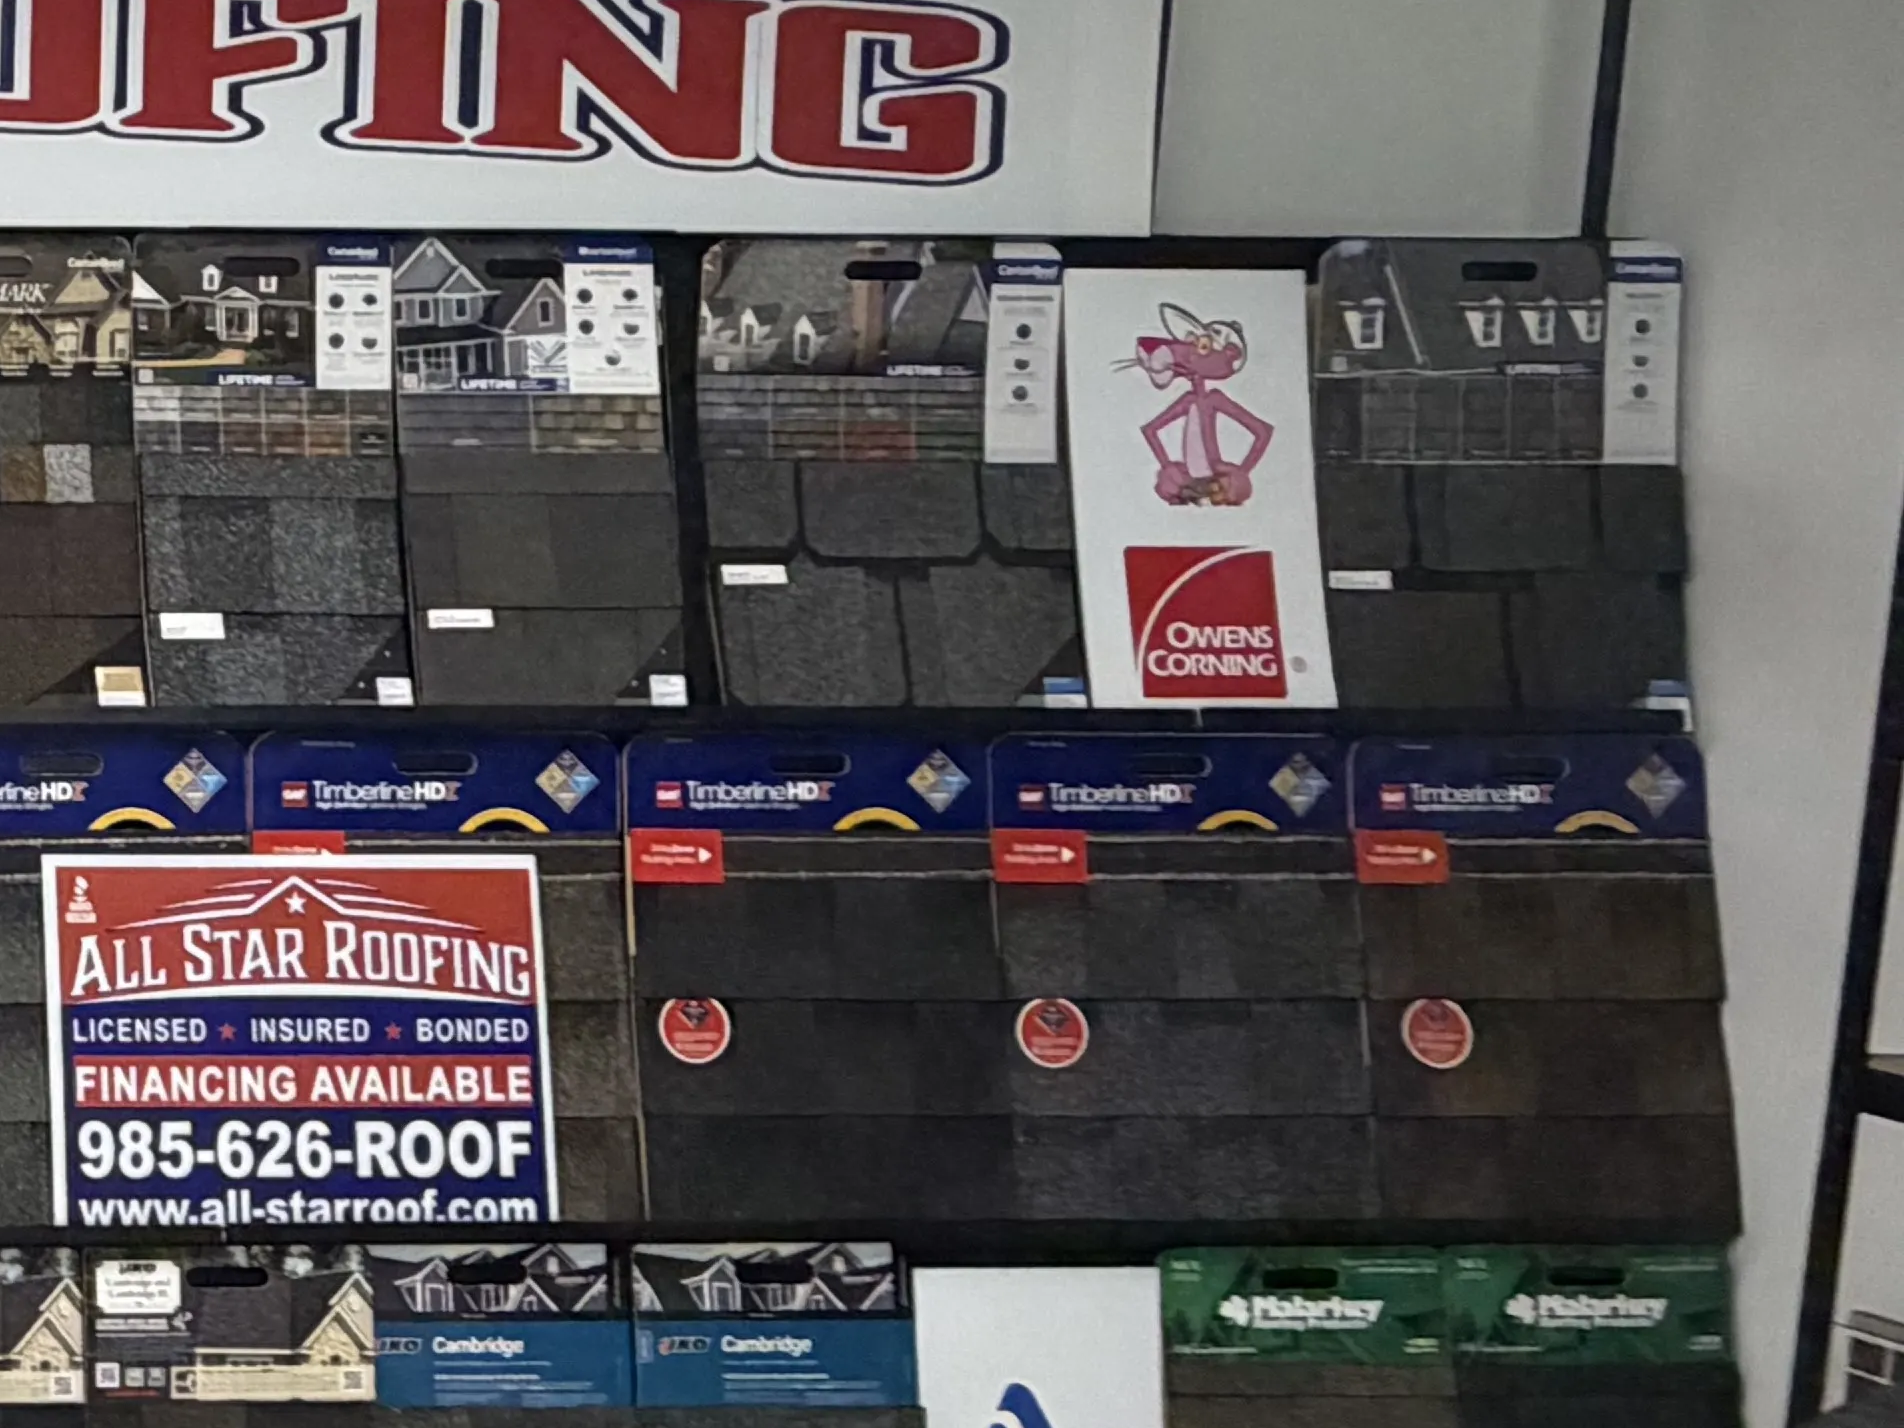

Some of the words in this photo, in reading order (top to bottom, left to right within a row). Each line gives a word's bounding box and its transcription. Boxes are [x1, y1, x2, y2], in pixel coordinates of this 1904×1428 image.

[1166, 621, 1274, 649] OWENS
[1147, 650, 1278, 678] CORNING
[70, 934, 167, 997] ALL
[182, 922, 308, 983] STAR
[322, 919, 532, 998] ROOFING
[73, 1016, 207, 1043] LICENSED
[250, 1018, 370, 1043] INSURED
[416, 1018, 530, 1043] BONDED
[74, 1065, 297, 1103] FINANCING
[310, 1065, 533, 1103] AVAILABLE
[77, 1118, 533, 1179] 985-626-ROOF
[79, 1188, 538, 1226] www.all-starroof.com
